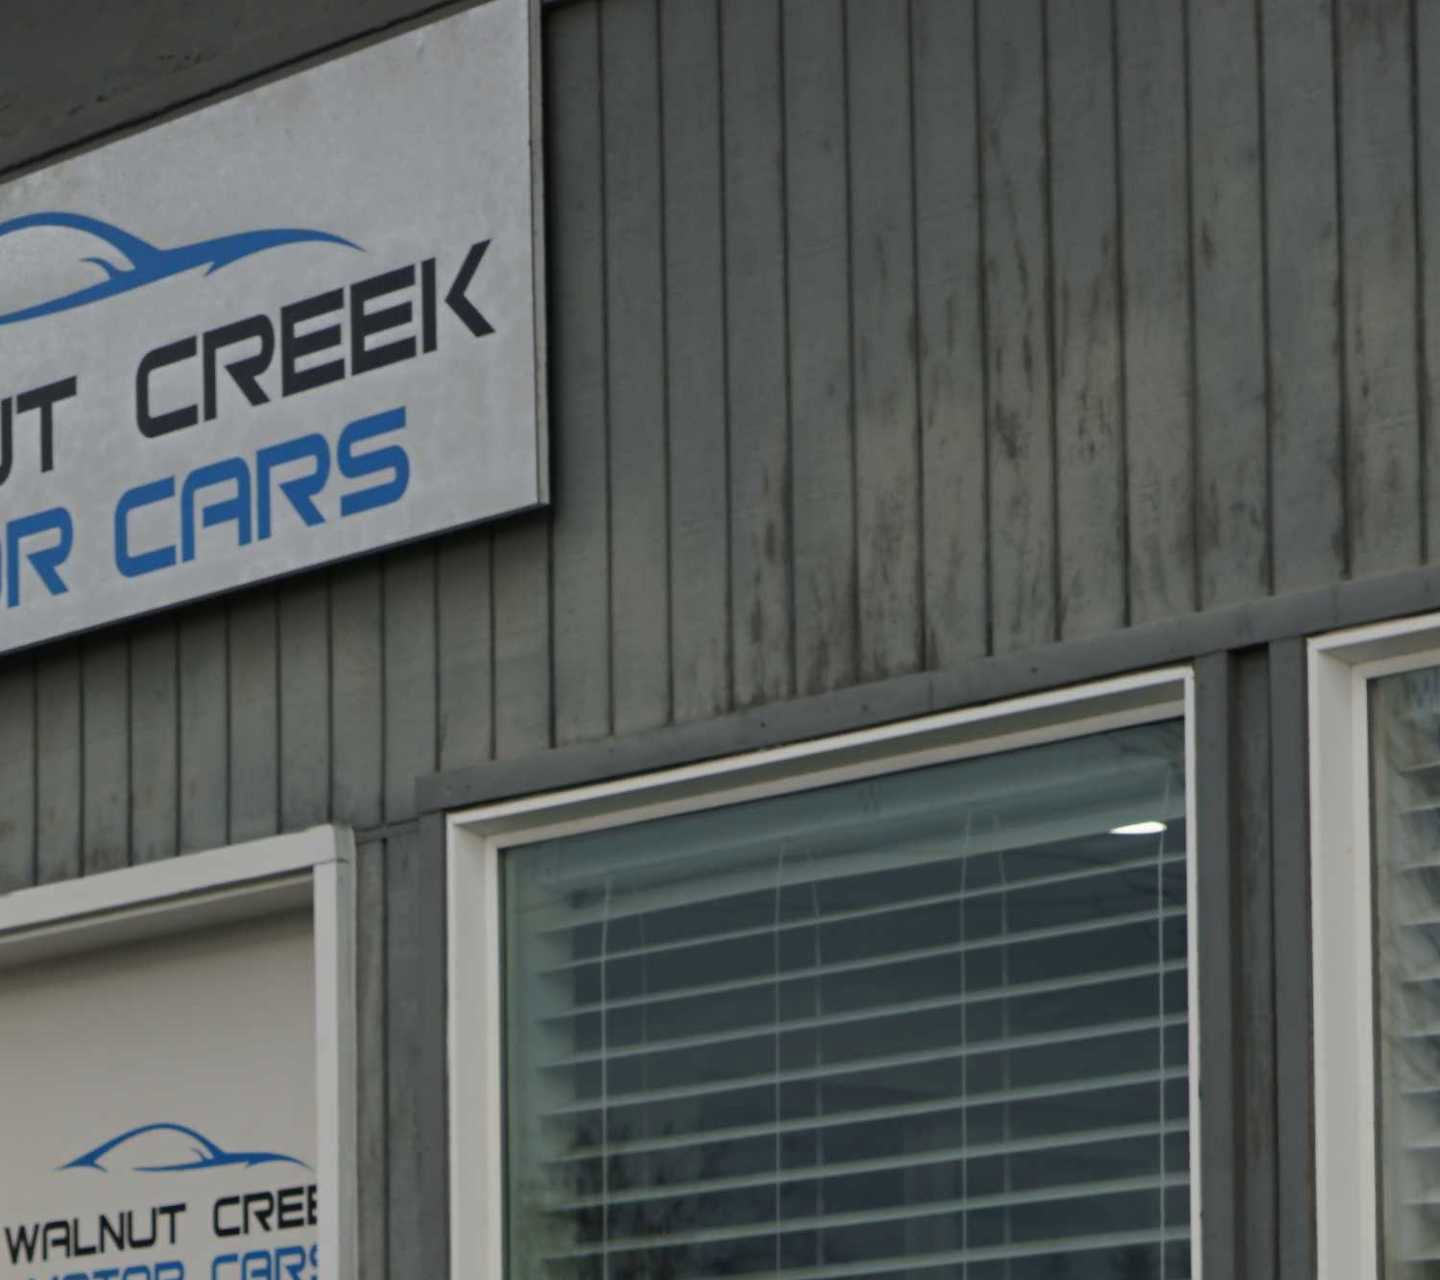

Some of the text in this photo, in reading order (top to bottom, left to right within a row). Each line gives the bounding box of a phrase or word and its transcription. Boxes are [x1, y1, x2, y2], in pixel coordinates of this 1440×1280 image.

[135, 239, 495, 438] CREEK
[114, 405, 410, 579] CARS
[4, 1203, 186, 1264] WALNUT
